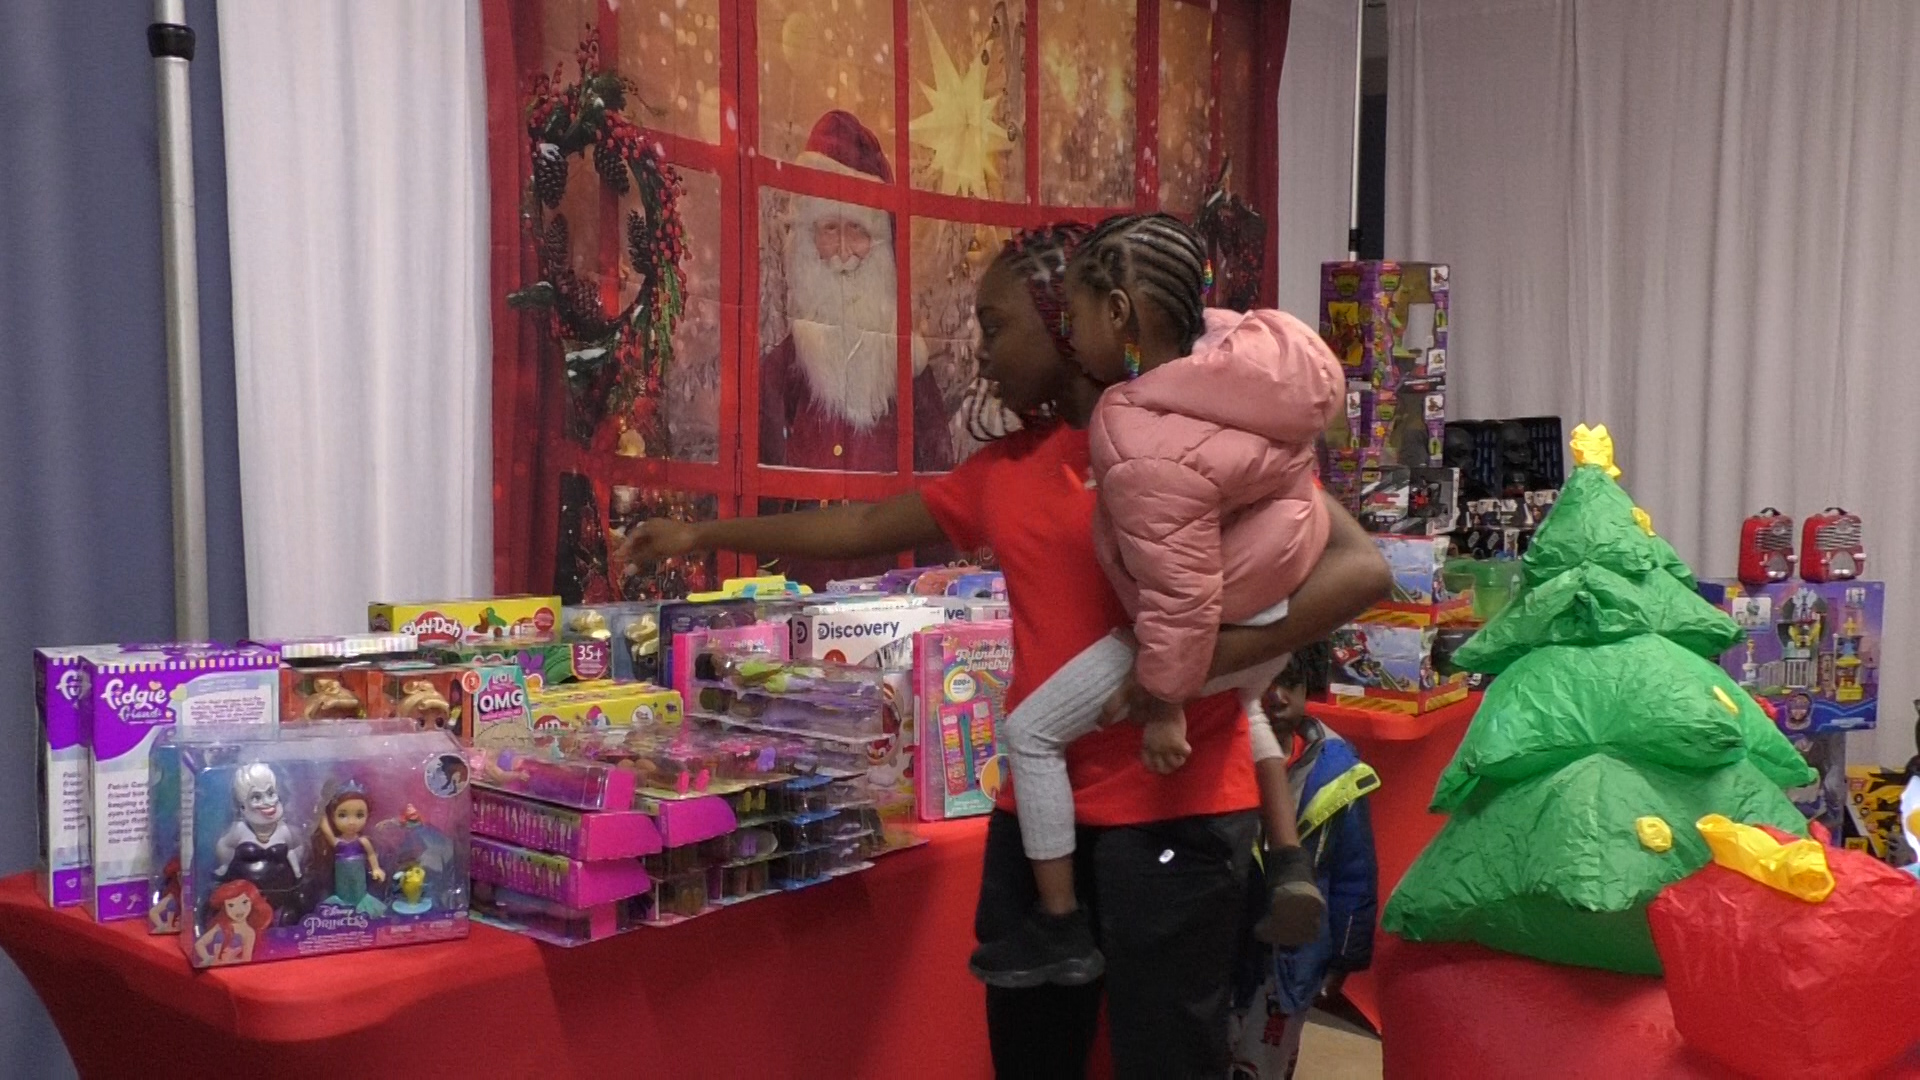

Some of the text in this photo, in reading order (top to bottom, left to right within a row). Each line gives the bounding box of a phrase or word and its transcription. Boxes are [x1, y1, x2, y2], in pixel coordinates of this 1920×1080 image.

[817, 620, 900, 640] Discovery
[577, 645, 604, 660] 35+
[479, 688, 524, 713] OMG
